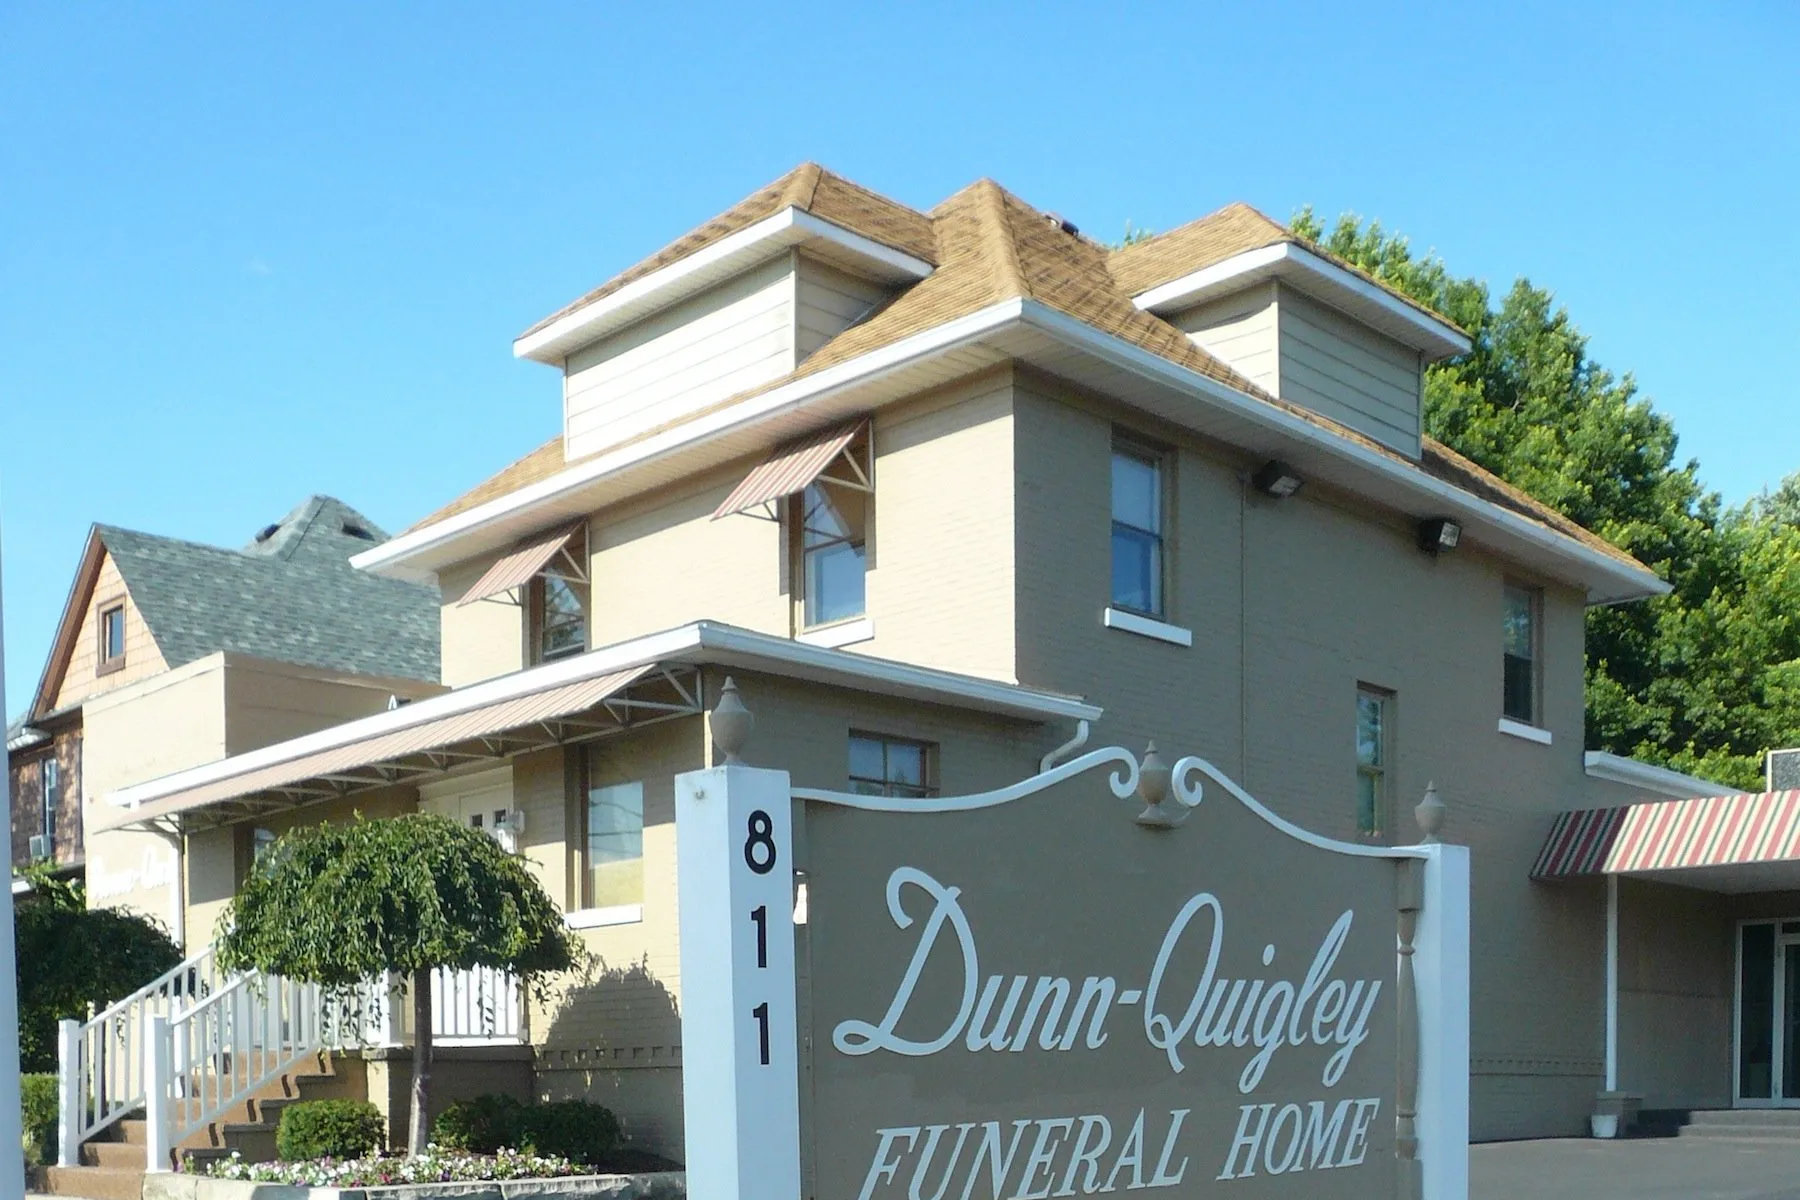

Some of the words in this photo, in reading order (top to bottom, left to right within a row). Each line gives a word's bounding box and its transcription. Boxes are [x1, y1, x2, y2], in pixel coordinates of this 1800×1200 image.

[744, 809, 777, 1065] 811
[832, 866, 1383, 1094] Dunn-Quigley
[1216, 1097, 1381, 1182] HOME
